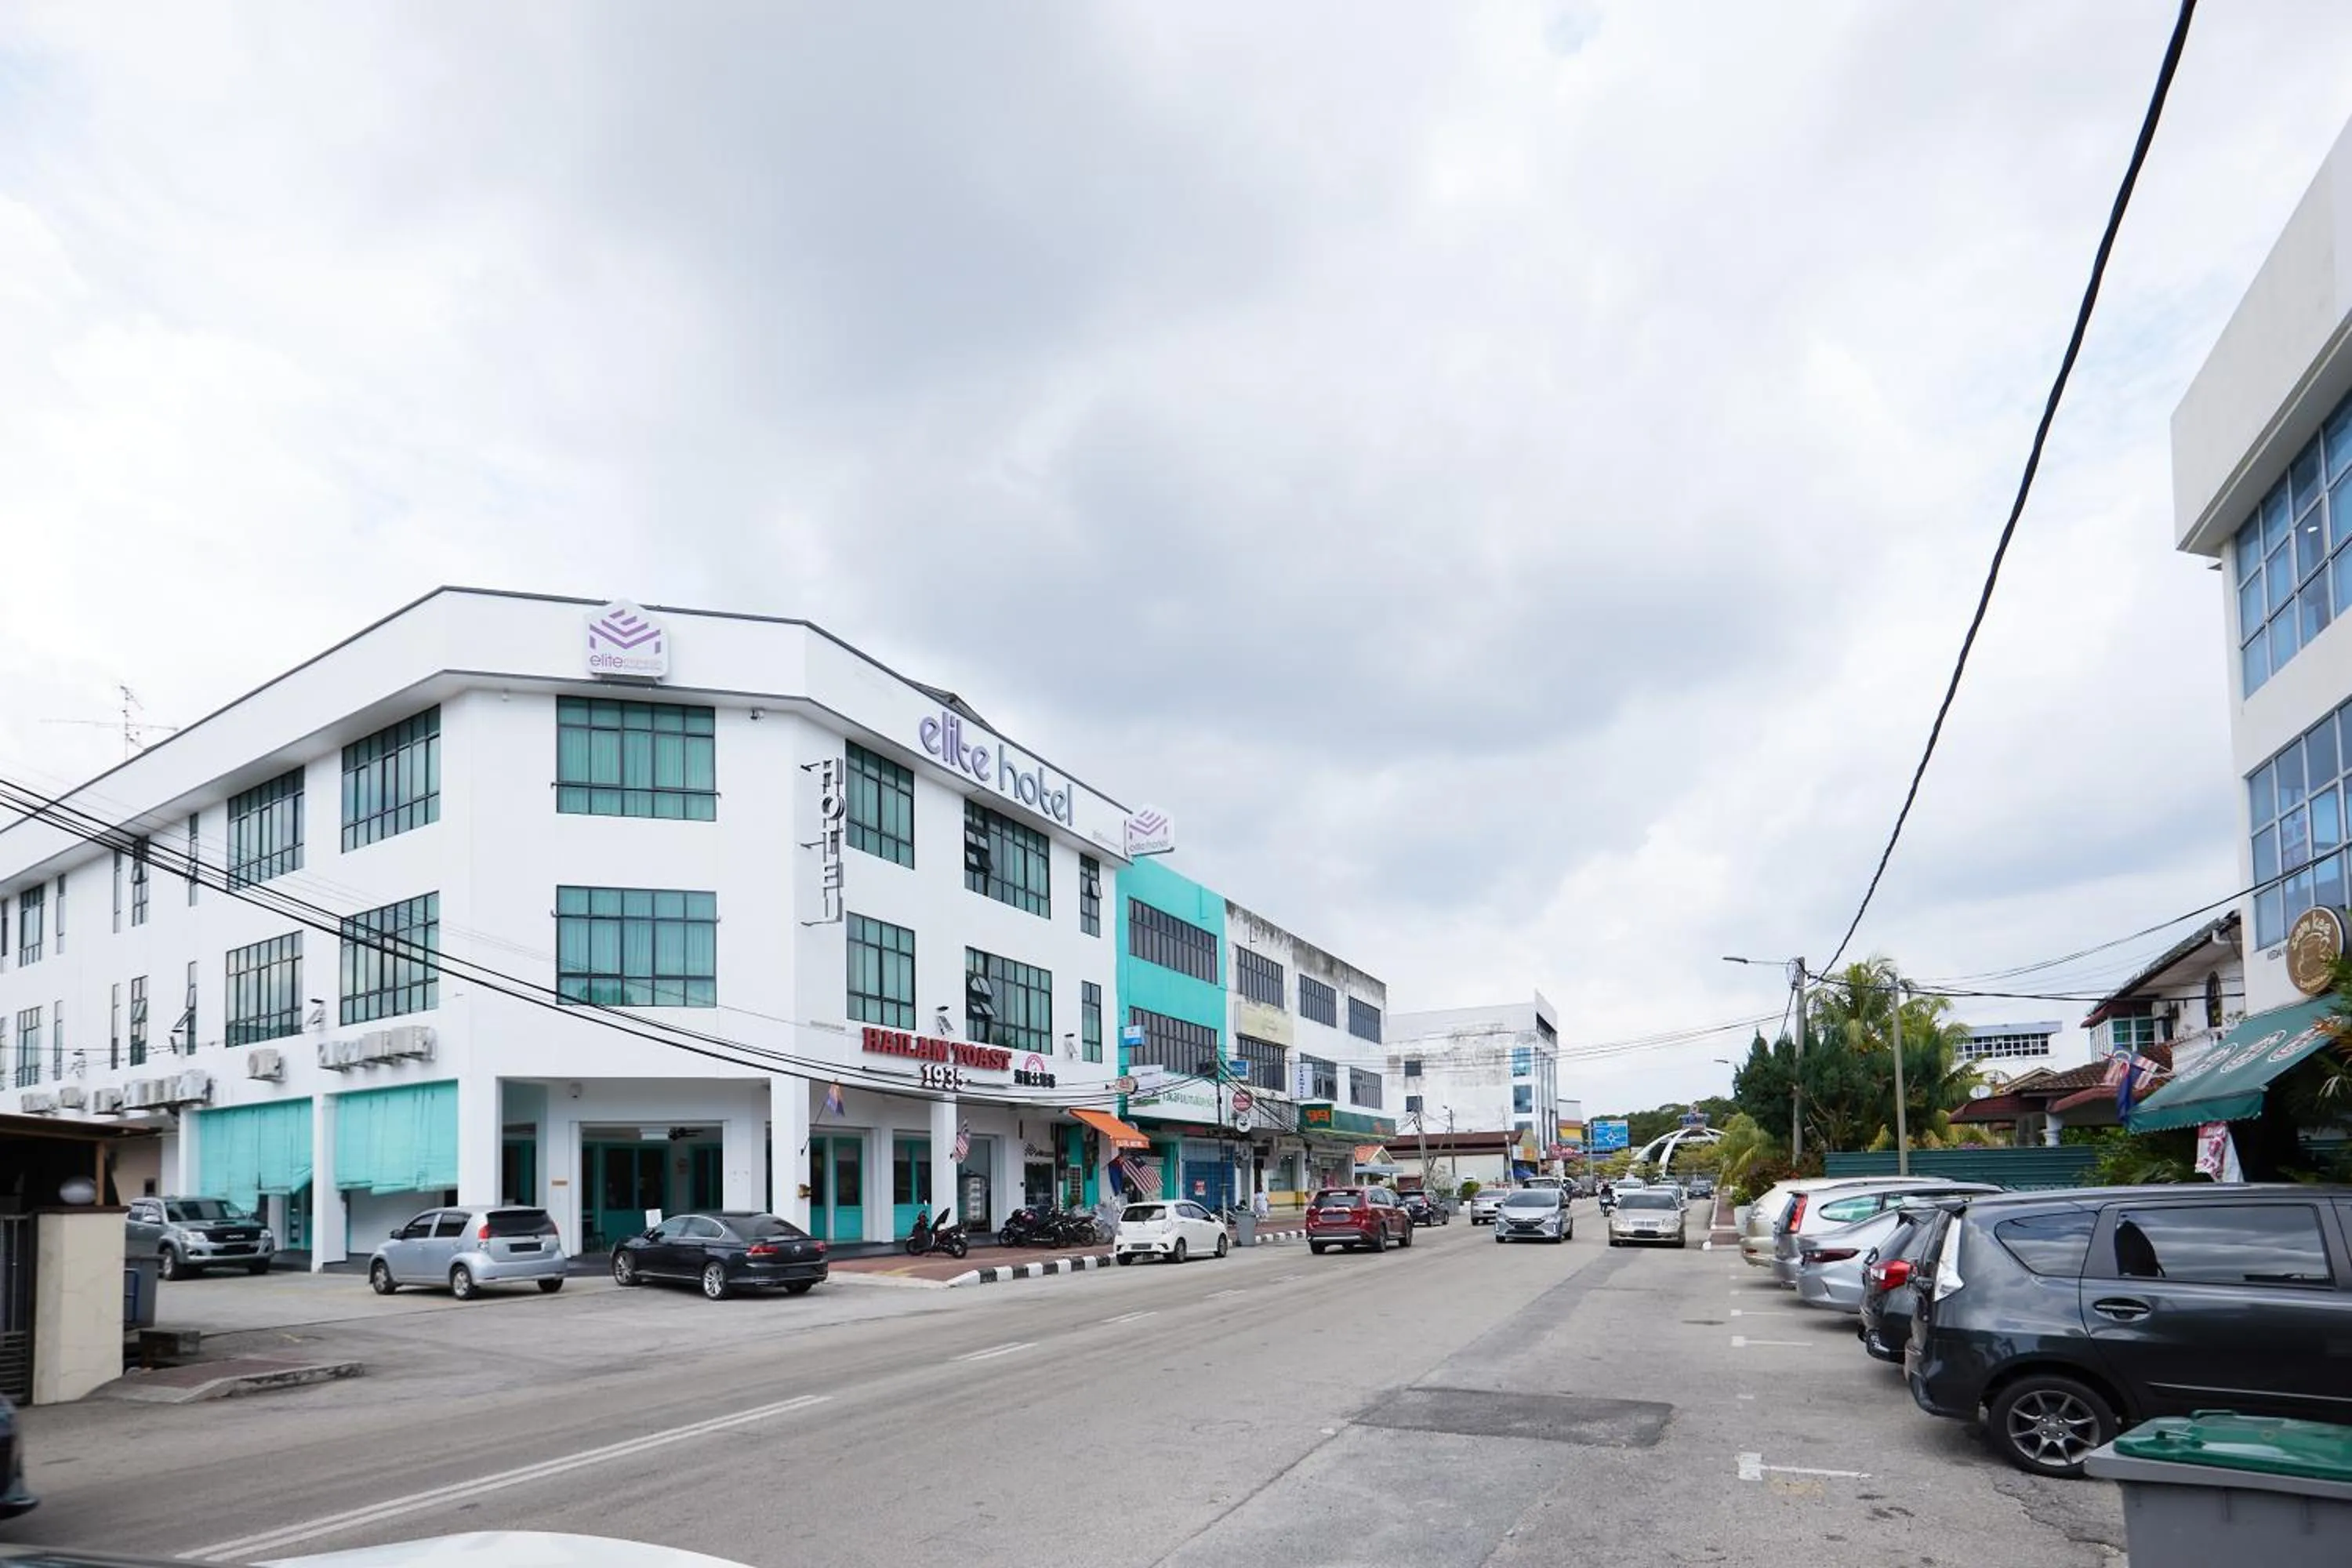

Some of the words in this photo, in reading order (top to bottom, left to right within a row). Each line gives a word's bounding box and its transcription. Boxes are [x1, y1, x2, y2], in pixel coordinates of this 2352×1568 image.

[590, 653, 623, 668] elite
[919, 710, 993, 782] elite
[998, 743, 1074, 827] hotel
[951, 1042, 1012, 1071] TOAST
[921, 1063, 966, 1091] 1935
